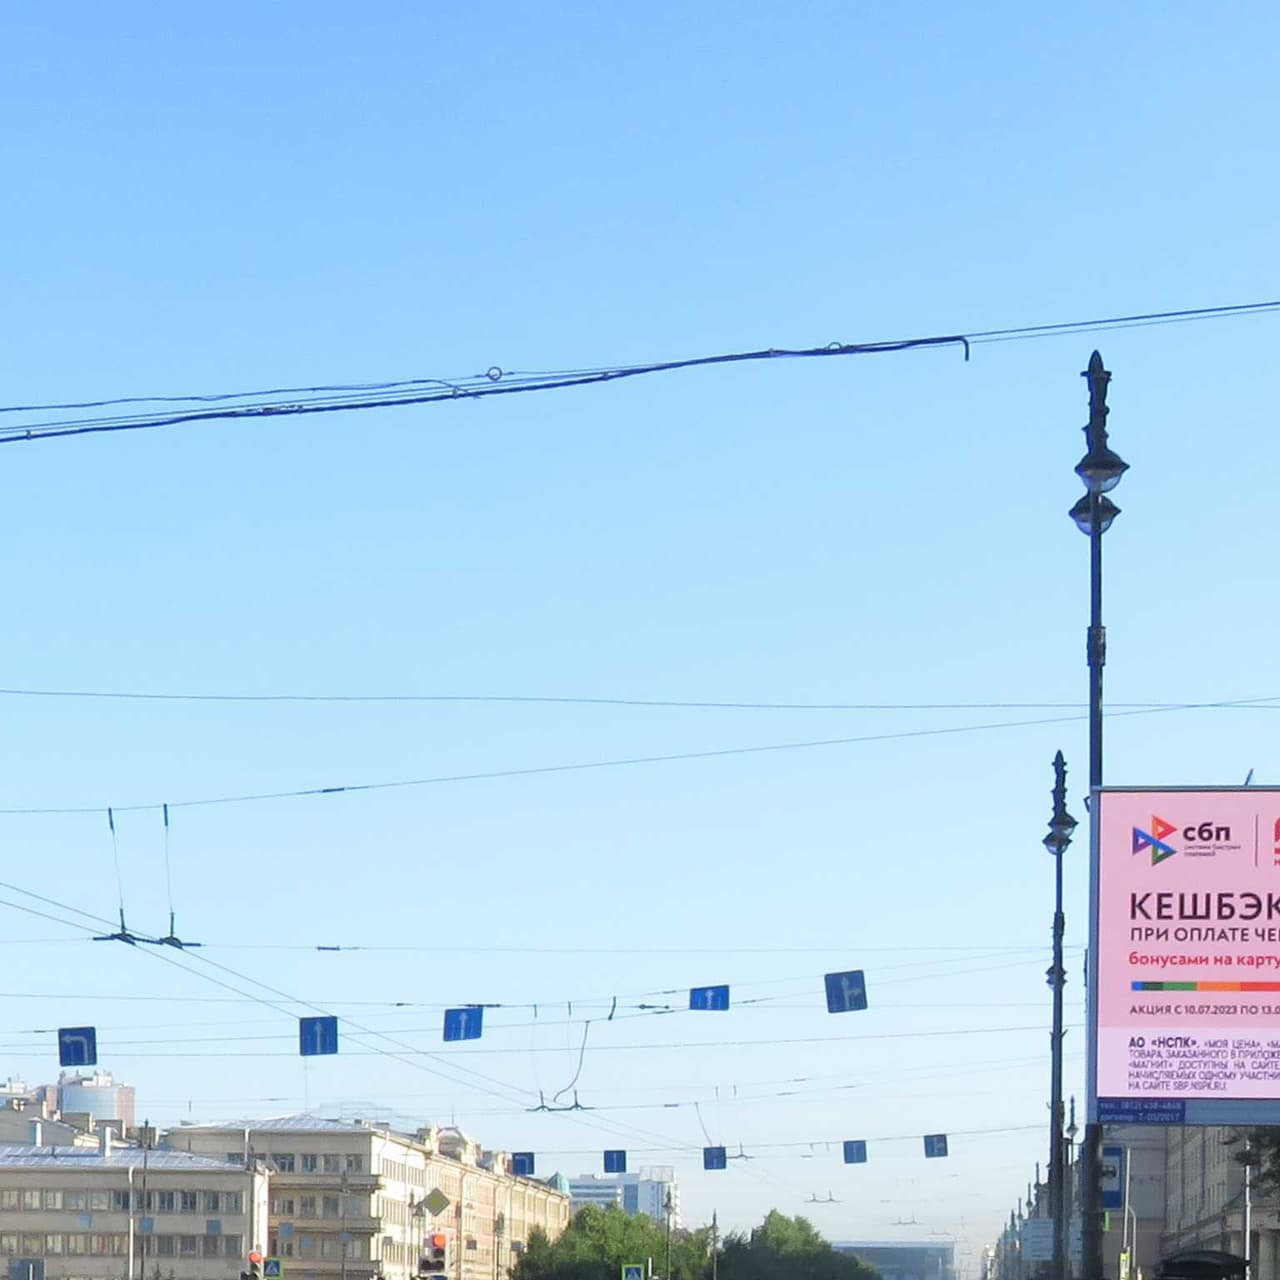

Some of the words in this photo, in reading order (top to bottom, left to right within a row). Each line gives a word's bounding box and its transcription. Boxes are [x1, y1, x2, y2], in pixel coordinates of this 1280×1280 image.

[1183, 821, 1231, 841] сбп
[1130, 927, 1169, 942] ПРИ
[1173, 927, 1250, 942] ОПЛАТЕ
[1128, 951, 1209, 969] бонусами
[1213, 956, 1233, 966] на
[1129, 1005, 1172, 1014] АКЦИЯ
[1174, 1005, 1182, 1014] С
[1184, 1005, 1238, 1014] 10.07.2023
[1240, 1005, 1259, 1014] ПО
[1128, 1037, 1146, 1048] АО
